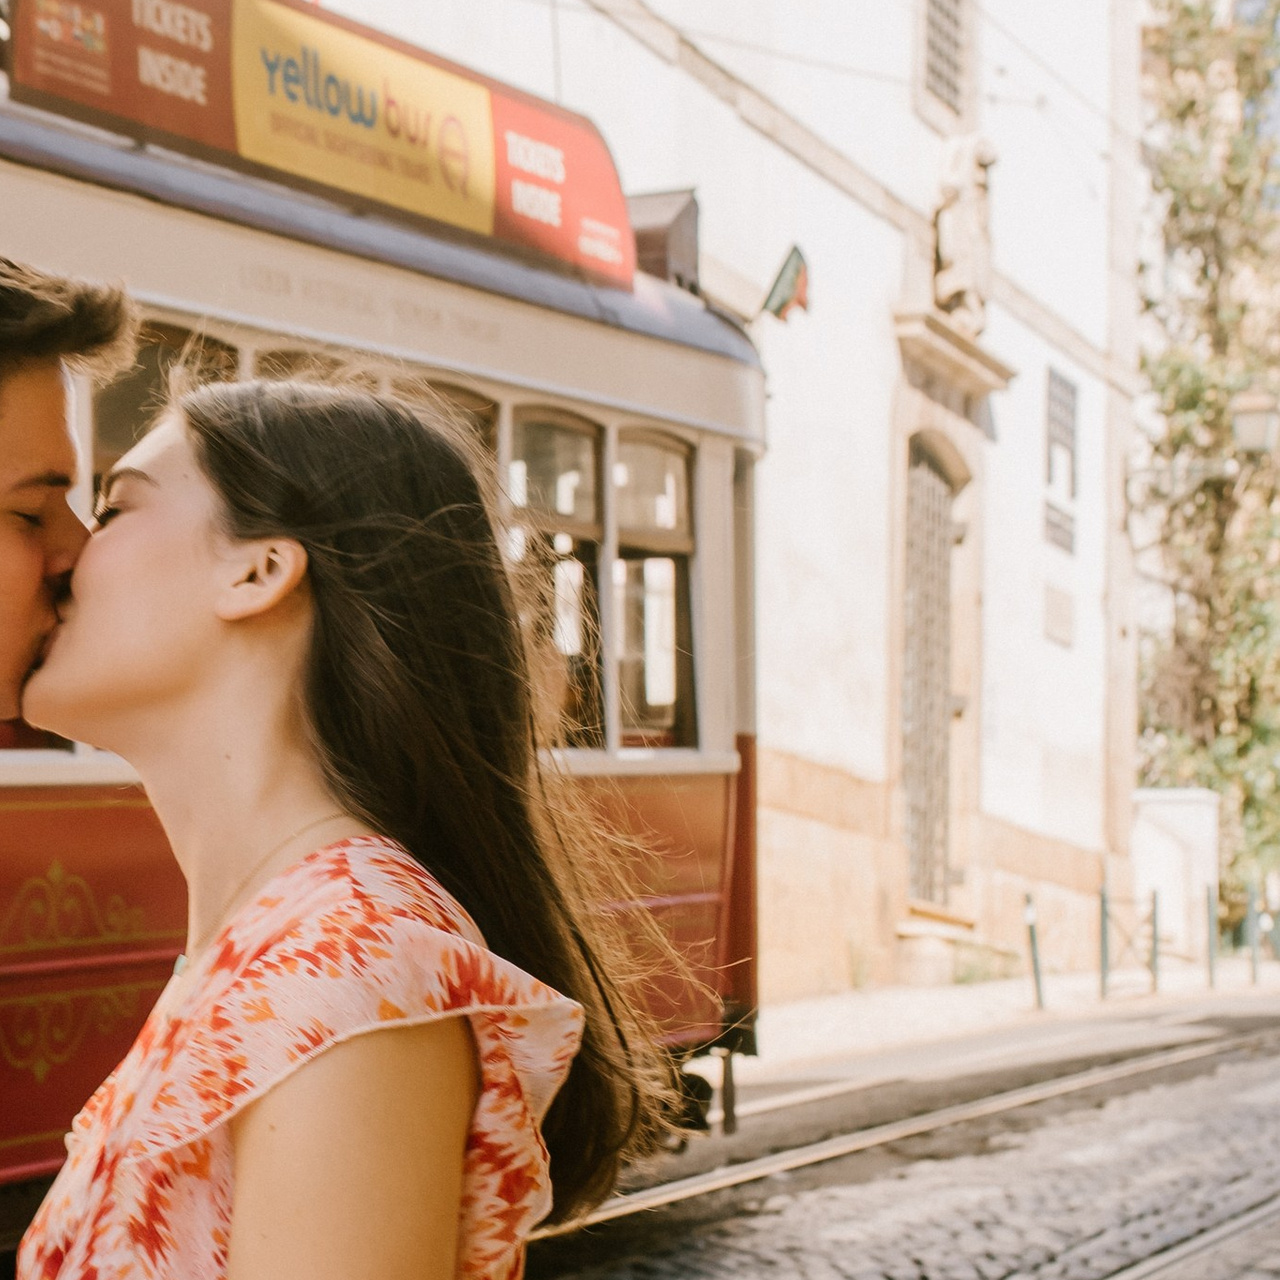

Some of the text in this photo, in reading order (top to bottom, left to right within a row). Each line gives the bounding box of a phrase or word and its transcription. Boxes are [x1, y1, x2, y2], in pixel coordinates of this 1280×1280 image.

[137, 45, 208, 107] INSIDE
[260, 44, 378, 129] yellow
[505, 130, 566, 184] TICKETS
[511, 178, 562, 228] INSIDE
